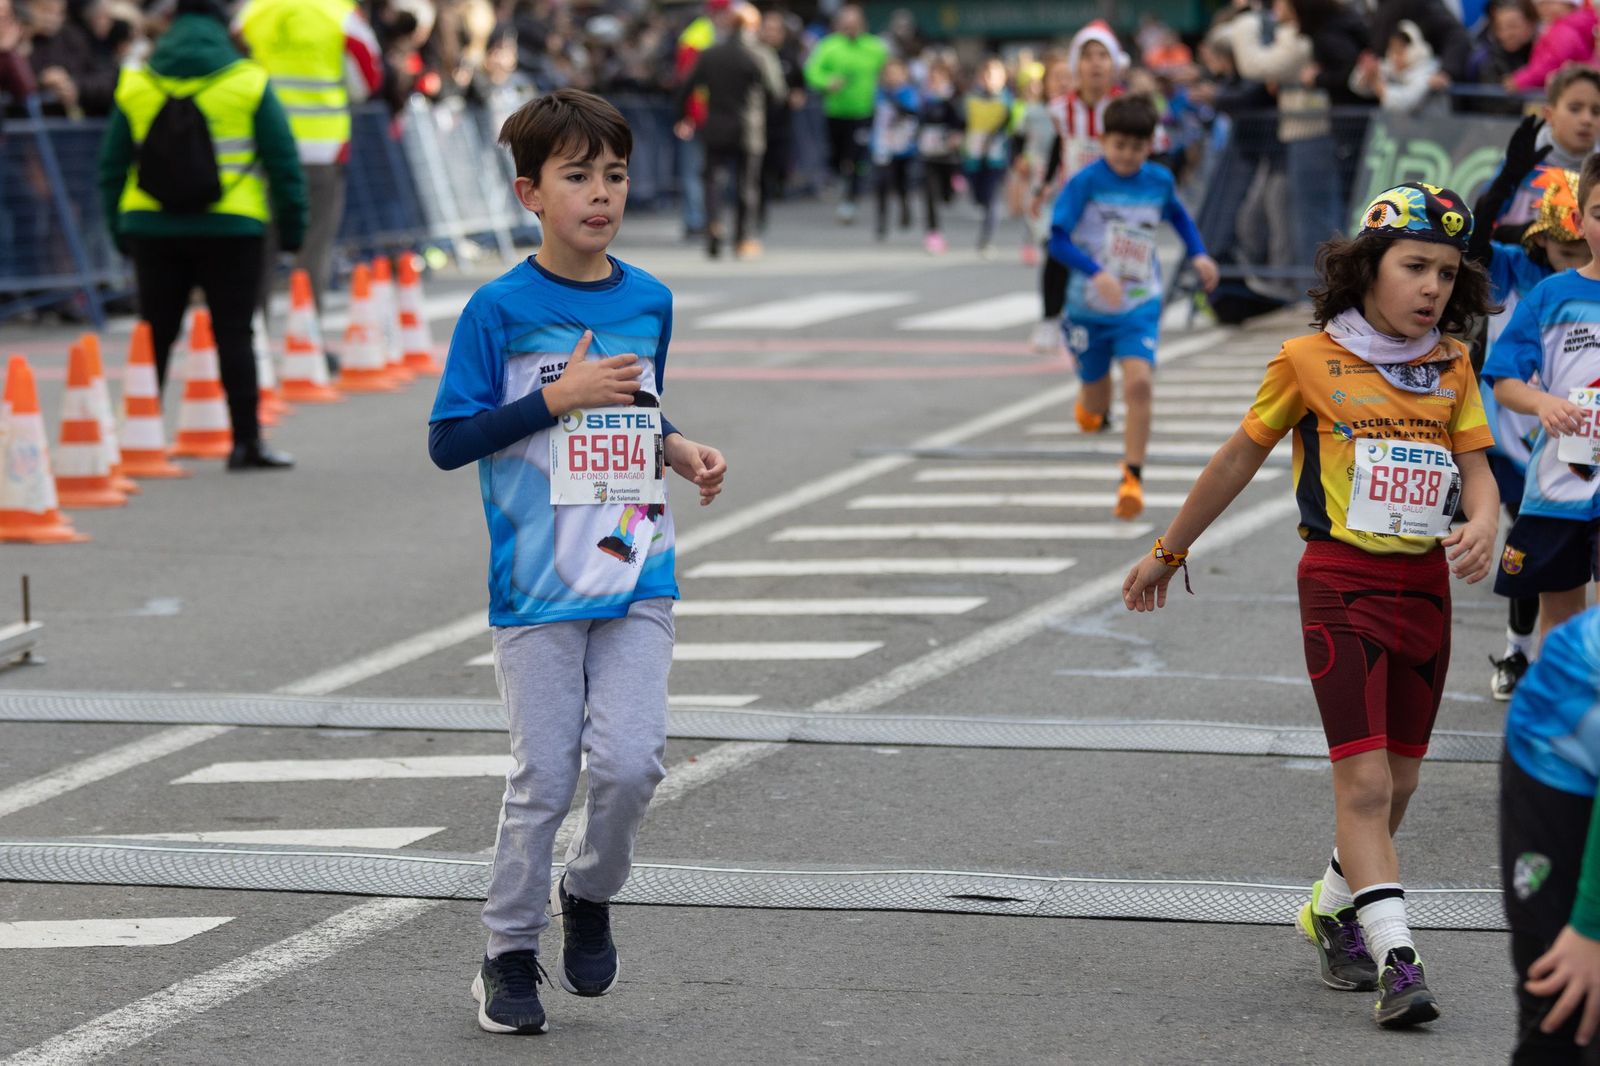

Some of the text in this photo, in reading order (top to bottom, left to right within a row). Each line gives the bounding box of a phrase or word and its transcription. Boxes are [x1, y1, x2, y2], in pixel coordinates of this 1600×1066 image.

[540, 364, 555, 374] XLI
[586, 414, 655, 429] SETEL
[1352, 418, 1405, 429] ESCUELA
[568, 434, 646, 472] 6594
[1391, 446, 1453, 467] SETEL
[613, 472, 645, 480] BRAGADO
[1369, 465, 1442, 507] 6838
